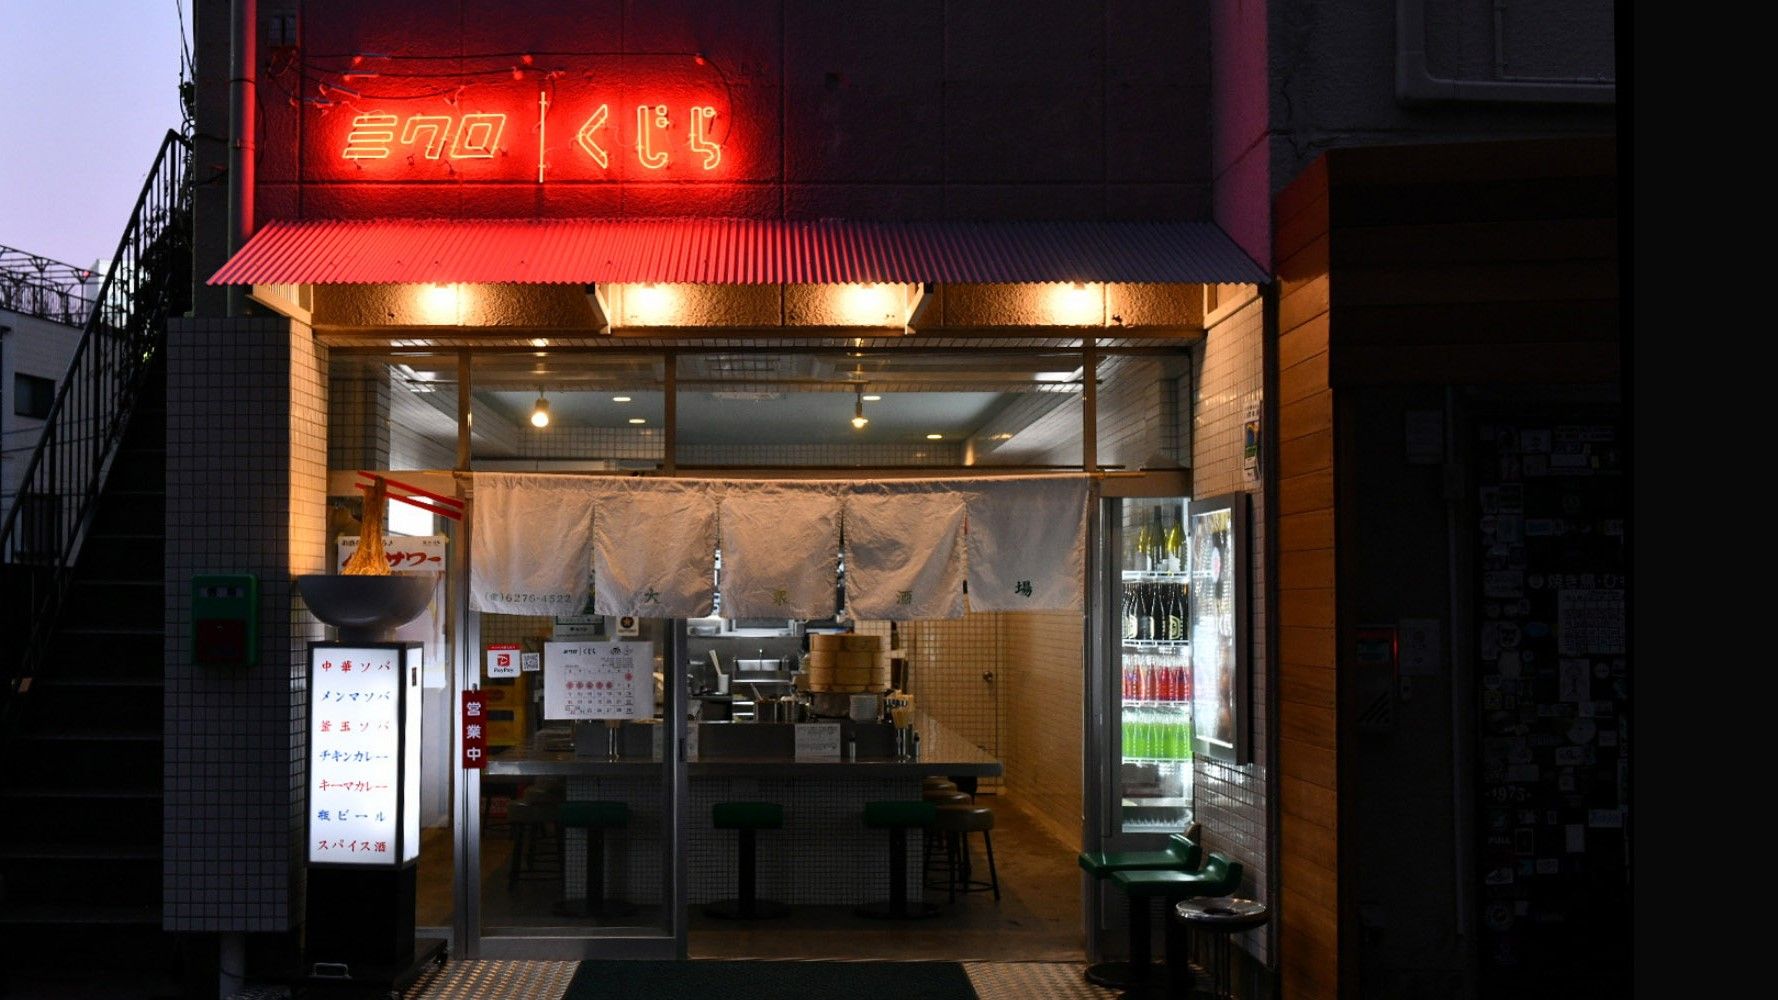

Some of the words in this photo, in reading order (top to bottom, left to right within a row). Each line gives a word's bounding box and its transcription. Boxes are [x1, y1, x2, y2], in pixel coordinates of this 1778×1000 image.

[343, 112, 507, 160] ミクロ
[576, 103, 721, 171] くじら
[322, 660, 391, 673] 中華ソバ
[322, 690, 391, 702] メンマソバ
[321, 720, 389, 732] 釜玉ソバ
[466, 701, 482, 762] 営業中
[319, 750, 389, 762] チキンカレー
[319, 779, 389, 792] キーマカレー
[318, 840, 386, 852] スパイス酒
